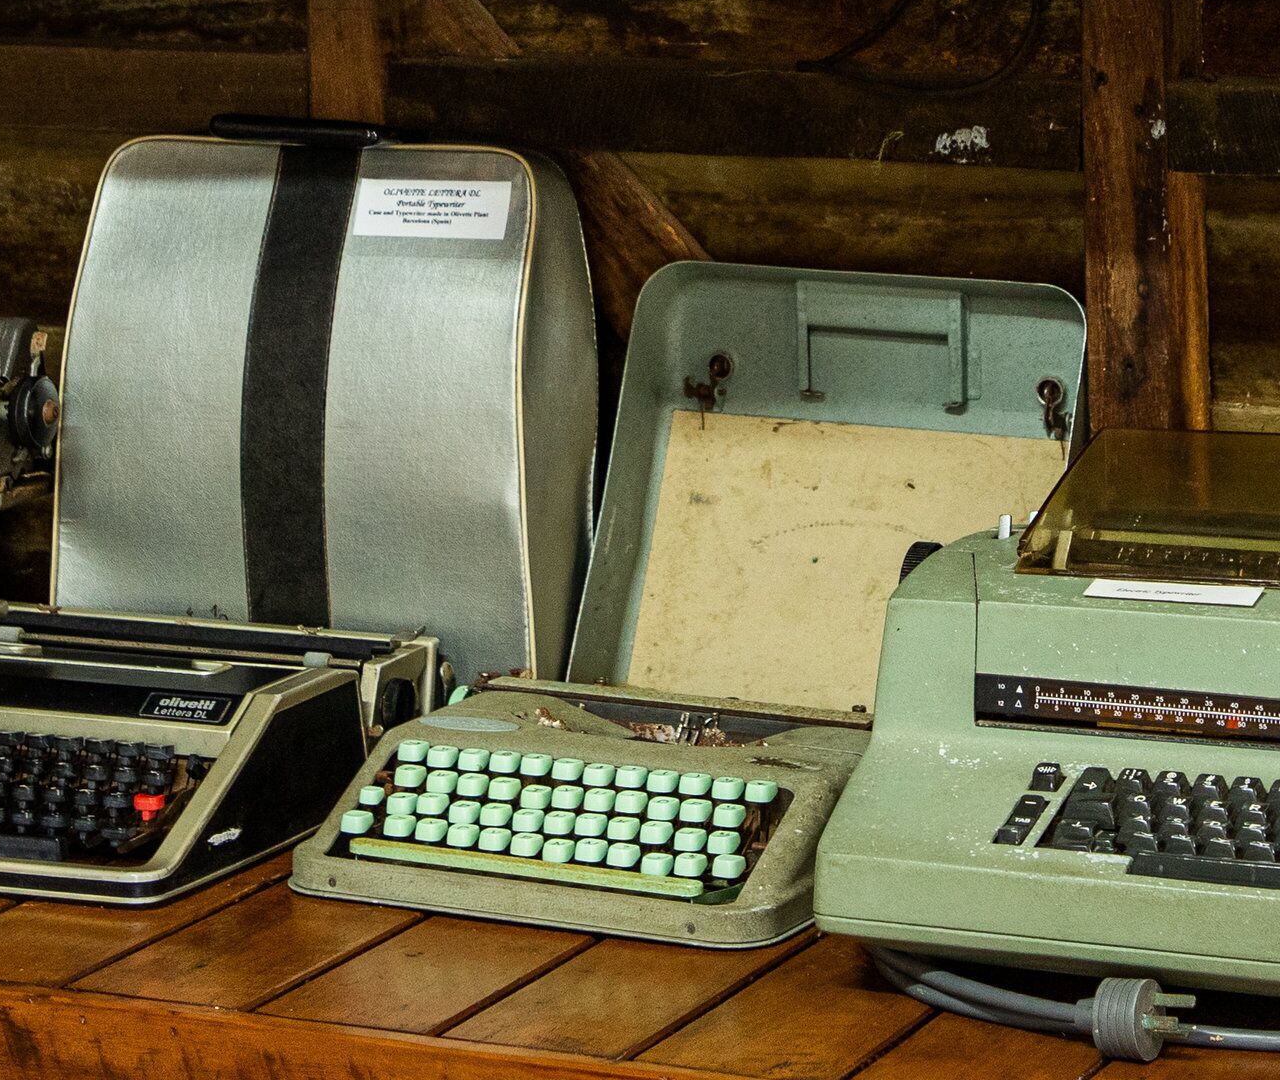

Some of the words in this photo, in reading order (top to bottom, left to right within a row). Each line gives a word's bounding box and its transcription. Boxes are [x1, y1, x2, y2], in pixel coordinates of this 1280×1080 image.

[159, 697, 216, 710] olivetti
[154, 706, 192, 718] Lettera
[194, 710, 207, 718] DL
